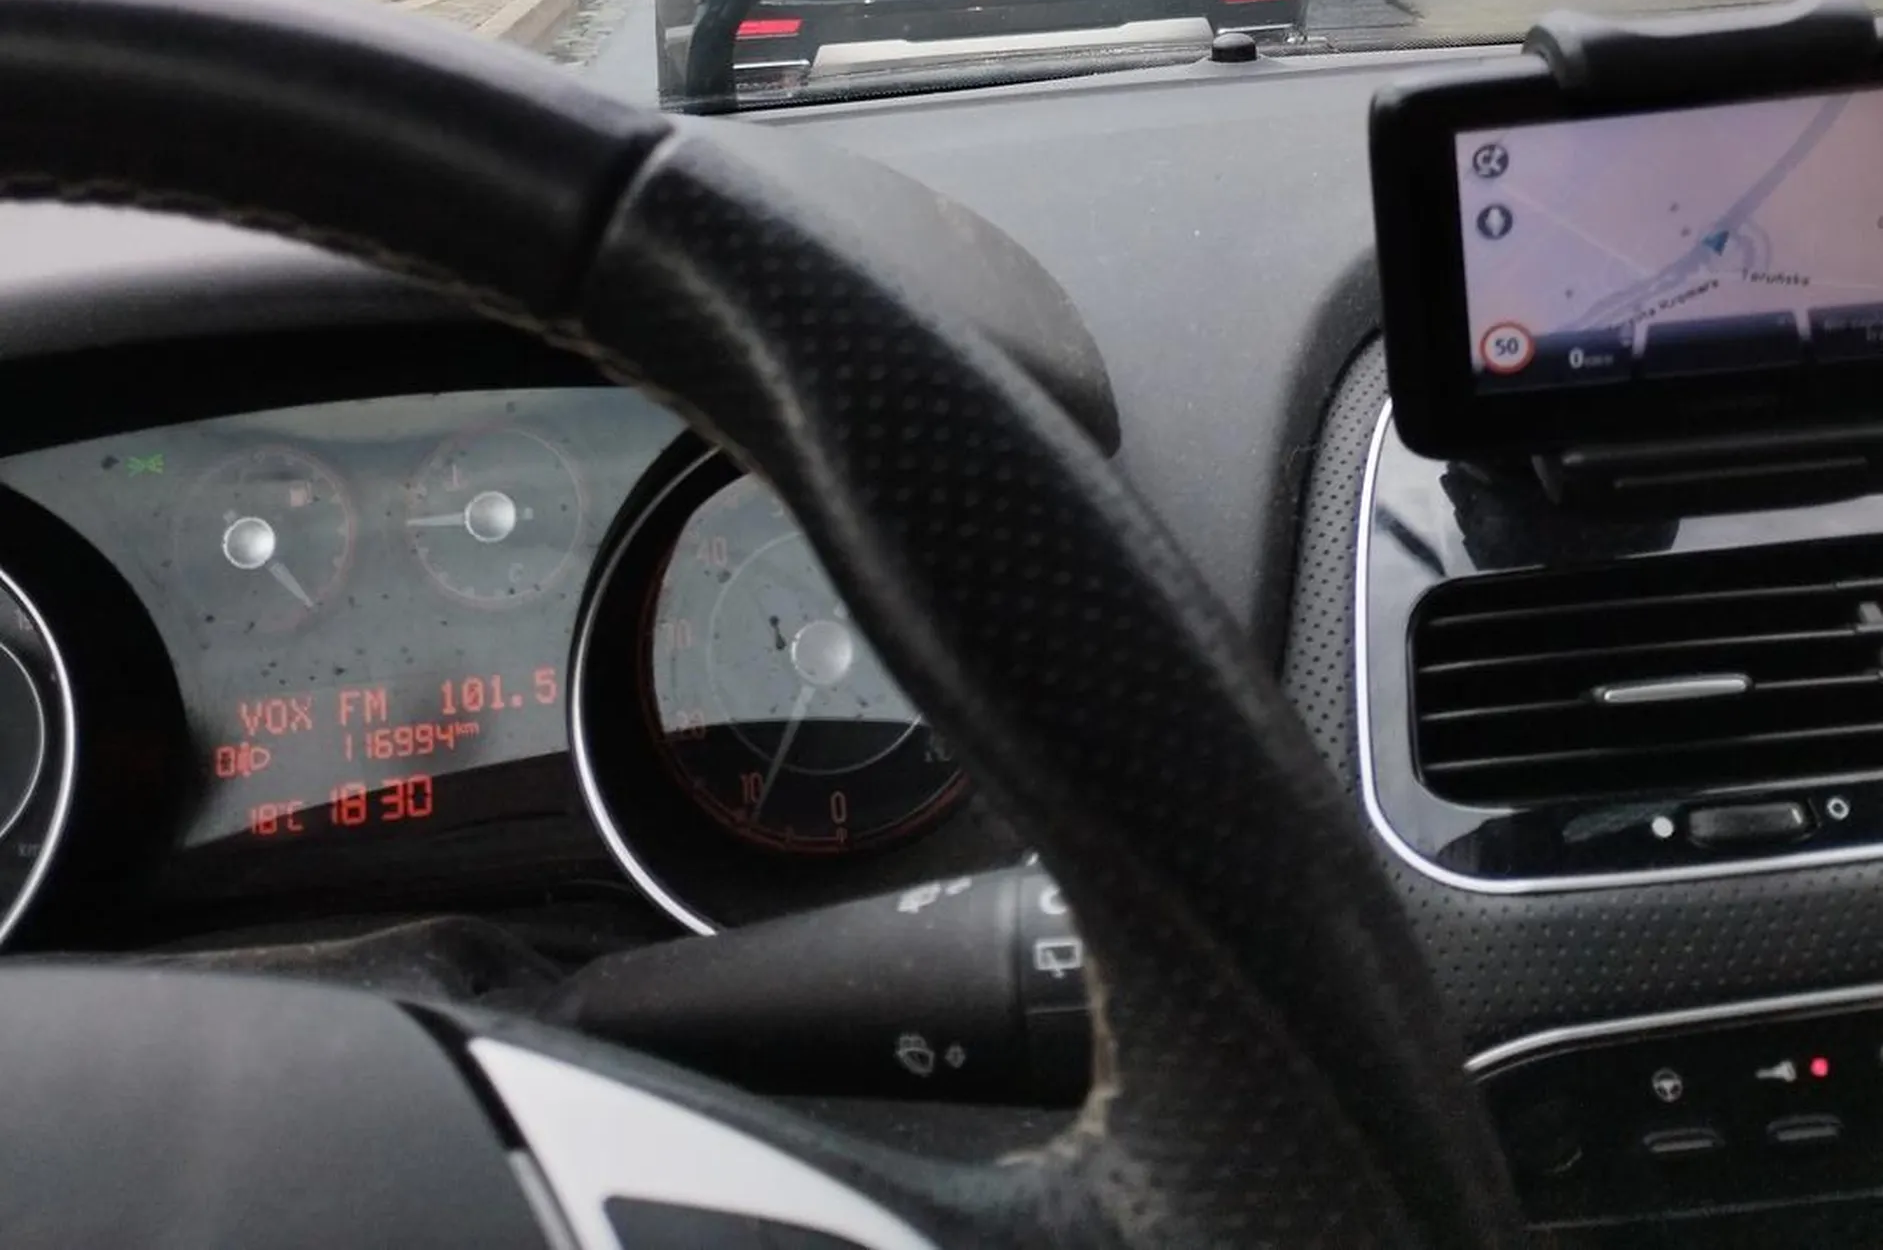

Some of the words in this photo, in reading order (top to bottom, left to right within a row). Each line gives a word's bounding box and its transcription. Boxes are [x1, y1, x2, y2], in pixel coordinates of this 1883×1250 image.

[1495, 337, 1519, 356] 50
[240, 696, 313, 736] VOX
[340, 688, 388, 726] FM
[440, 668, 557, 715] 101.5
